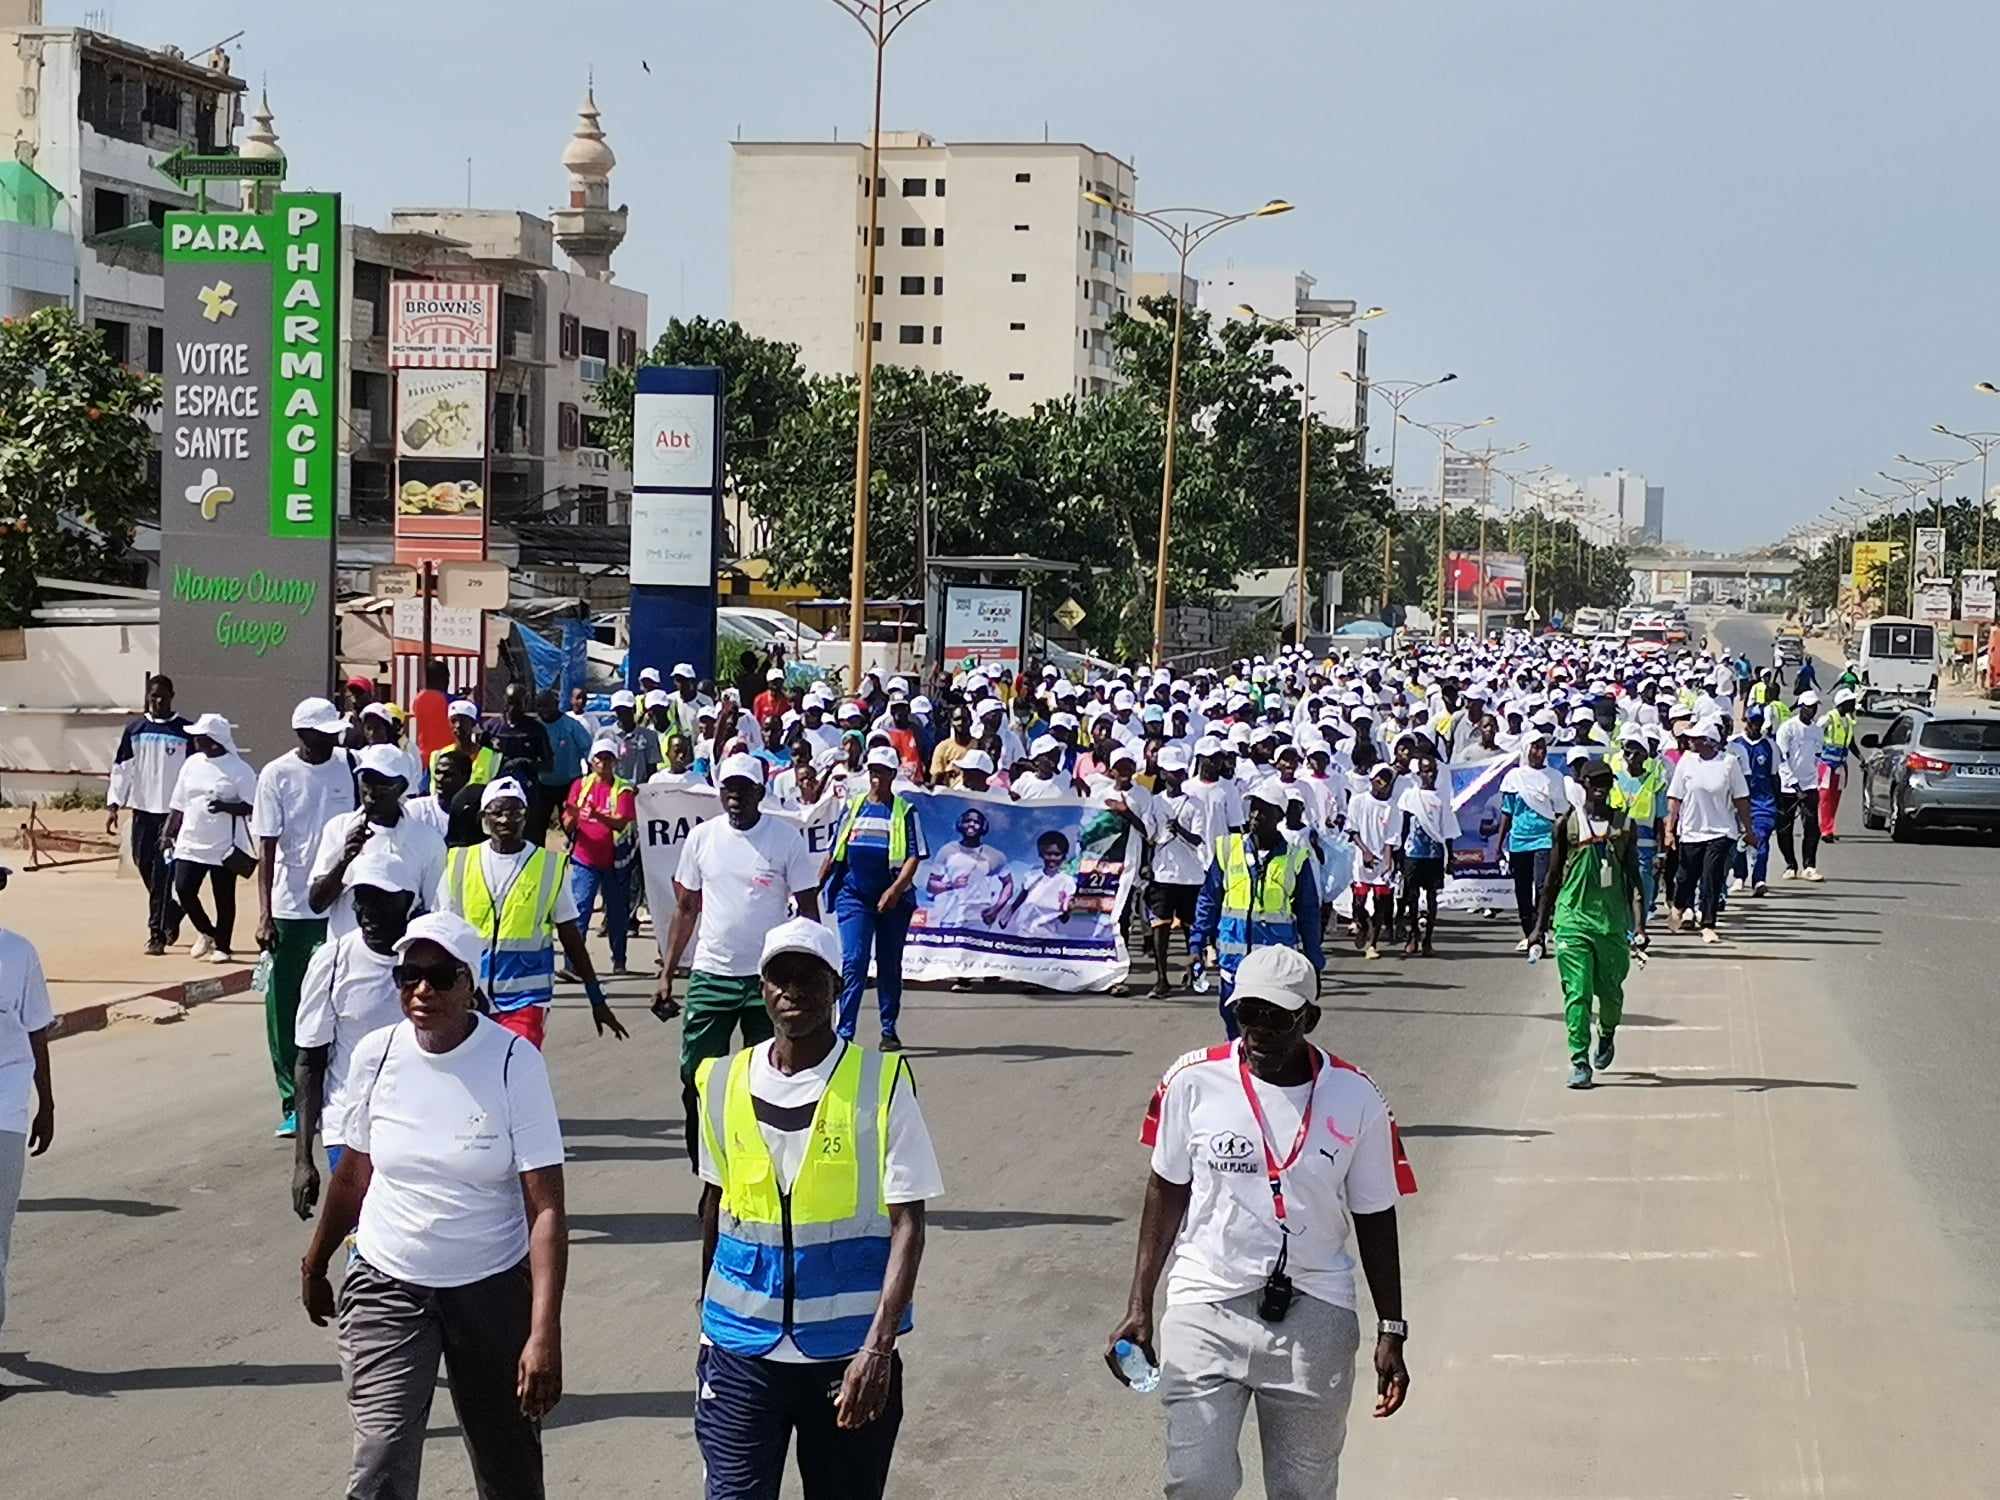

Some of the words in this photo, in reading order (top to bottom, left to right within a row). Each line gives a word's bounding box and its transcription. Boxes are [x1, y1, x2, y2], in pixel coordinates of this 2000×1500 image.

[172, 224, 264, 251] PARA
[405, 300, 482, 315] BROWN'S
[176, 342, 250, 375] VOTRE
[281, 207, 323, 521] PHARMACIE
[175, 385, 260, 417] ESPACE
[175, 426, 250, 459] SANTE
[656, 430, 691, 448] Abt
[173, 564, 245, 601] Mame
[248, 569, 317, 616] Oumy
[216, 611, 288, 656] Gueye
[823, 1136, 842, 1153] 25
